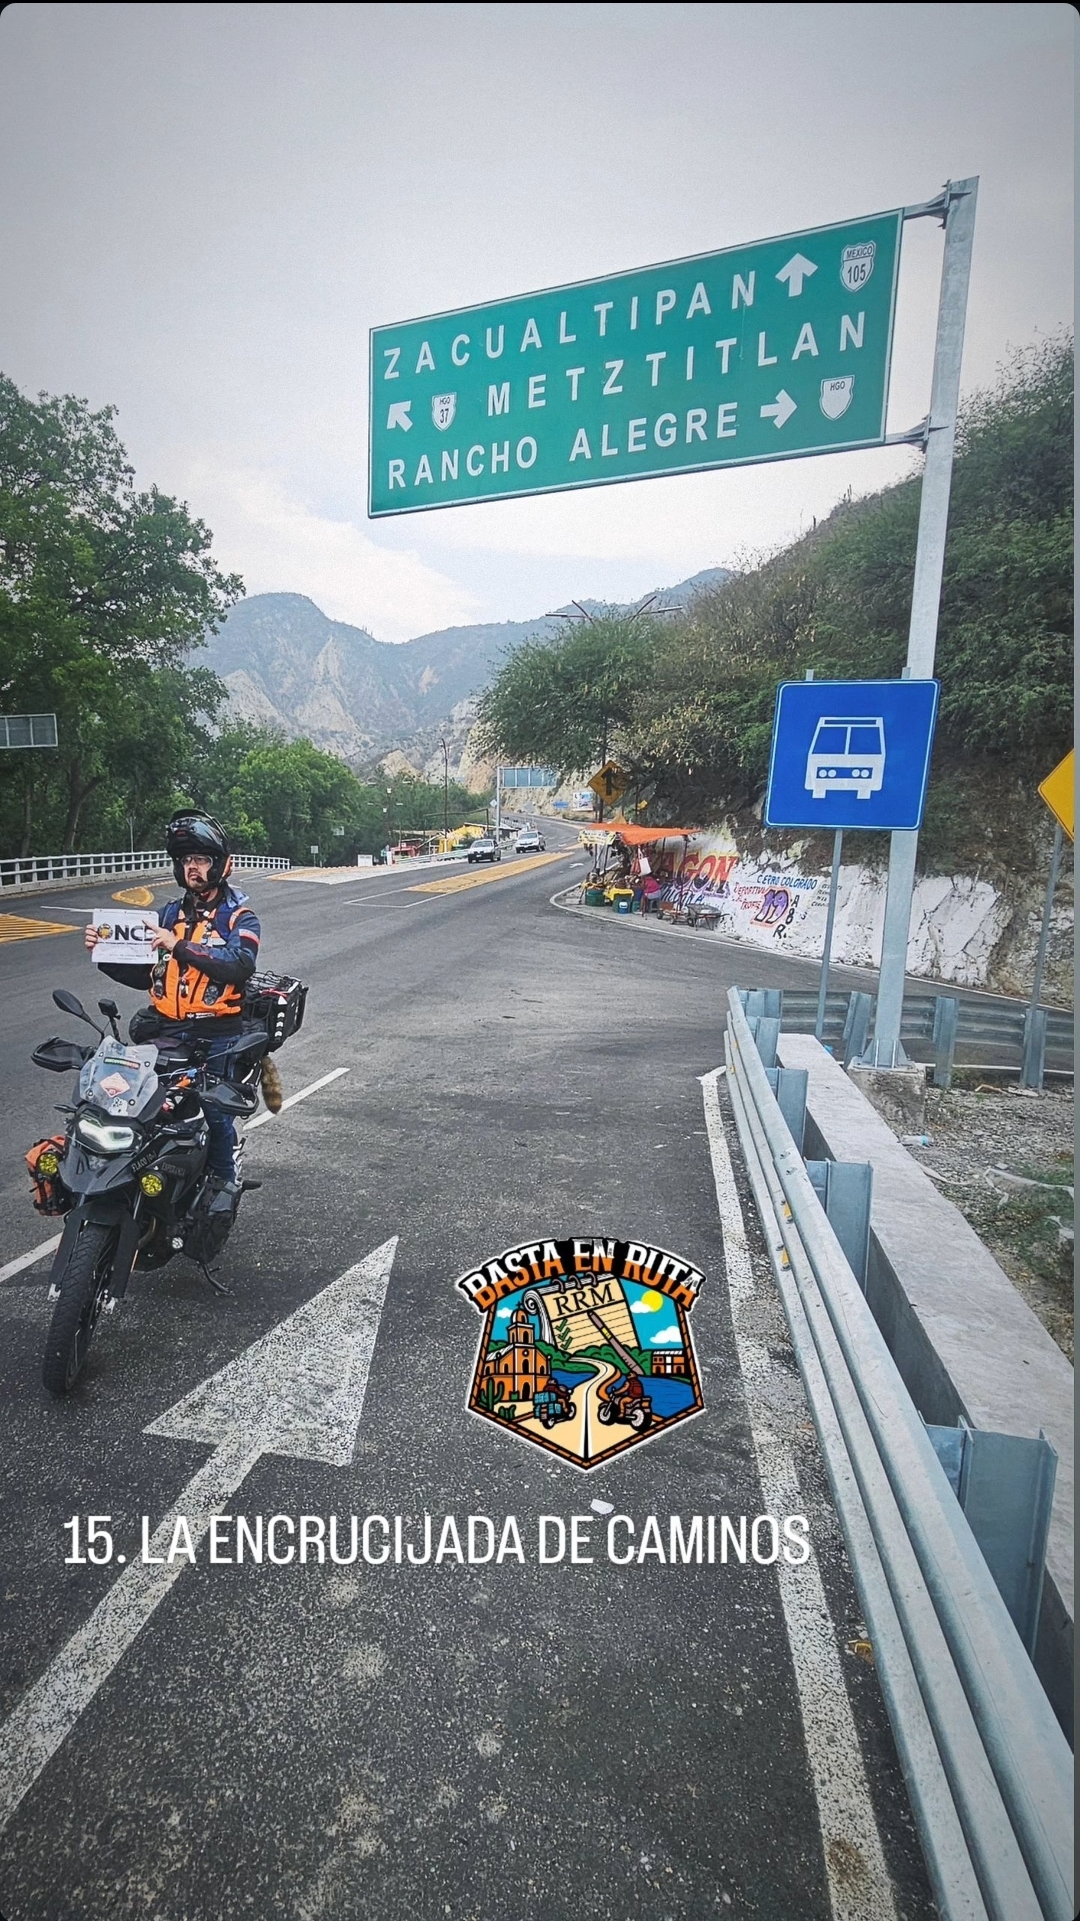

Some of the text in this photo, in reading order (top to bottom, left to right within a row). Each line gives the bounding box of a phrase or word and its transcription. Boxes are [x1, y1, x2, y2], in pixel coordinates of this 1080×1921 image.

[845, 246, 873, 259] MEXICO
[847, 263, 867, 284] 105
[384, 270, 756, 379] ZACUALTIPAN
[487, 311, 866, 417] METZTITLAN
[829, 380, 846, 392] HGO
[440, 396, 451, 405] HGO
[440, 408, 449, 424] 37
[388, 401, 738, 489] RANCHO ALEGRE
[754, 889, 789, 924] 19
